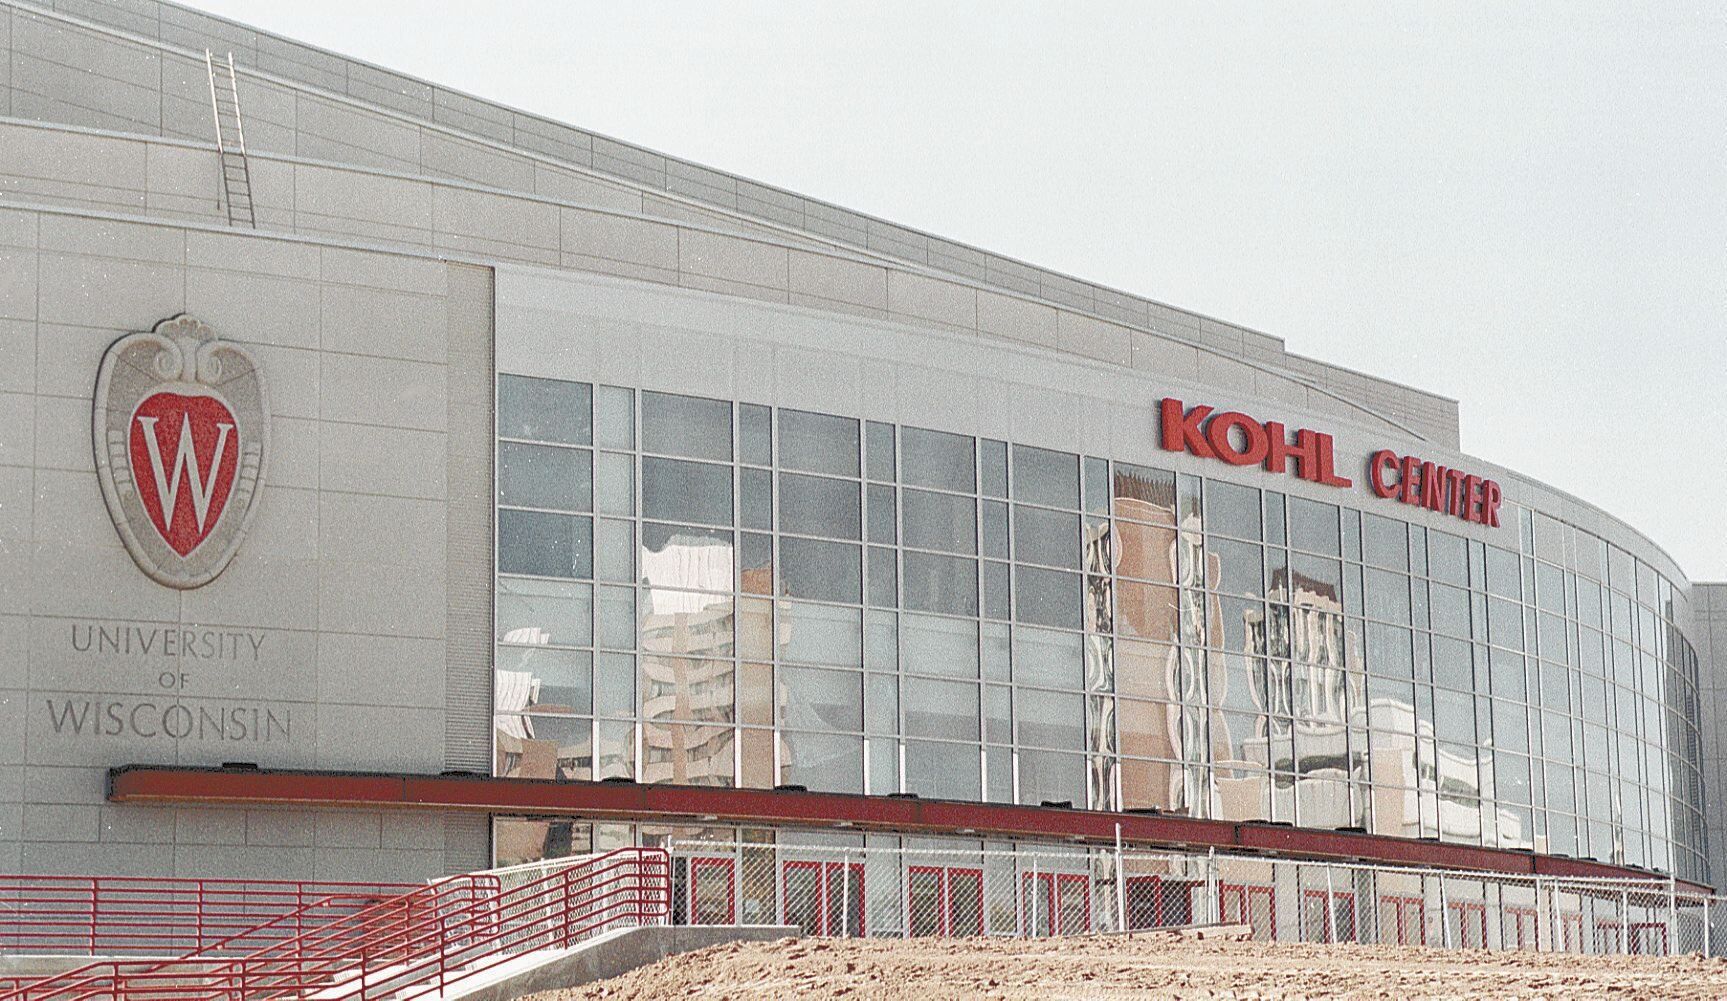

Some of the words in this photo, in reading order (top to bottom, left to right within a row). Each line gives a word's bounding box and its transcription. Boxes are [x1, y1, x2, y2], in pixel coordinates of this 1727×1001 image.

[137, 411, 234, 536] W
[1159, 397, 1353, 489] KOHL
[1369, 448, 1502, 528] CENTER
[71, 623, 265, 661] UNIVERSITY
[158, 670, 191, 689] OF
[46, 699, 292, 742] WISCONSIN
